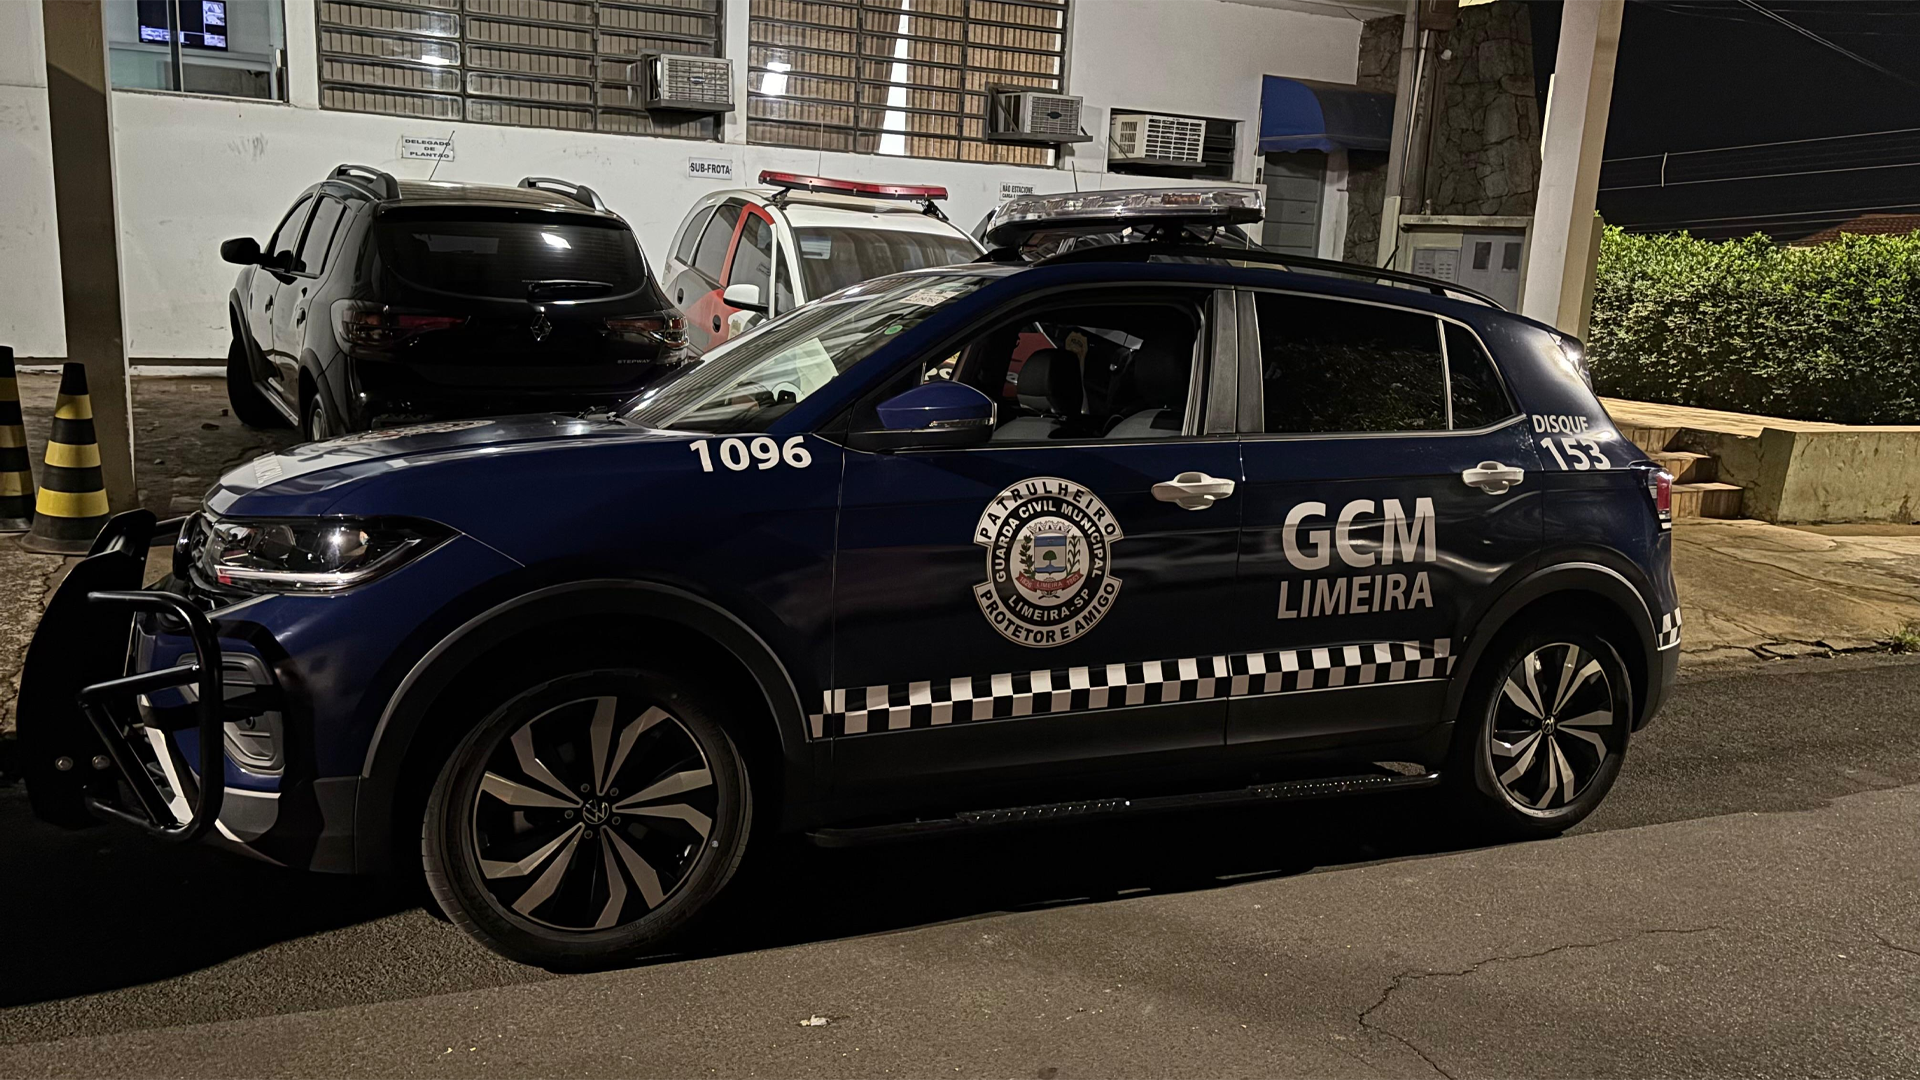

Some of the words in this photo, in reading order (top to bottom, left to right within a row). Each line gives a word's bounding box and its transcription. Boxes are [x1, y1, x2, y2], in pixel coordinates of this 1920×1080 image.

[405, 139, 451, 147] DELEGADO
[690, 162, 731, 174] SUB-FROTA
[1532, 414, 1589, 436] DISQUE
[689, 435, 813, 473] 1096
[1540, 437, 1611, 471] 153
[979, 481, 1117, 541] PATRULHEIRO
[994, 518, 1020, 583] GUARDA
[1018, 500, 1057, 519] CIVIL
[1061, 502, 1103, 578] MUNICIPAL
[1282, 497, 1437, 571] GCM
[980, 588, 1057, 644] PROTETOR
[1060, 625, 1071, 641] E
[1074, 582, 1116, 635] AMIGO
[1007, 588, 1090, 622] LIMEIRA-SP
[1277, 571, 1434, 620] LIMEIRA
